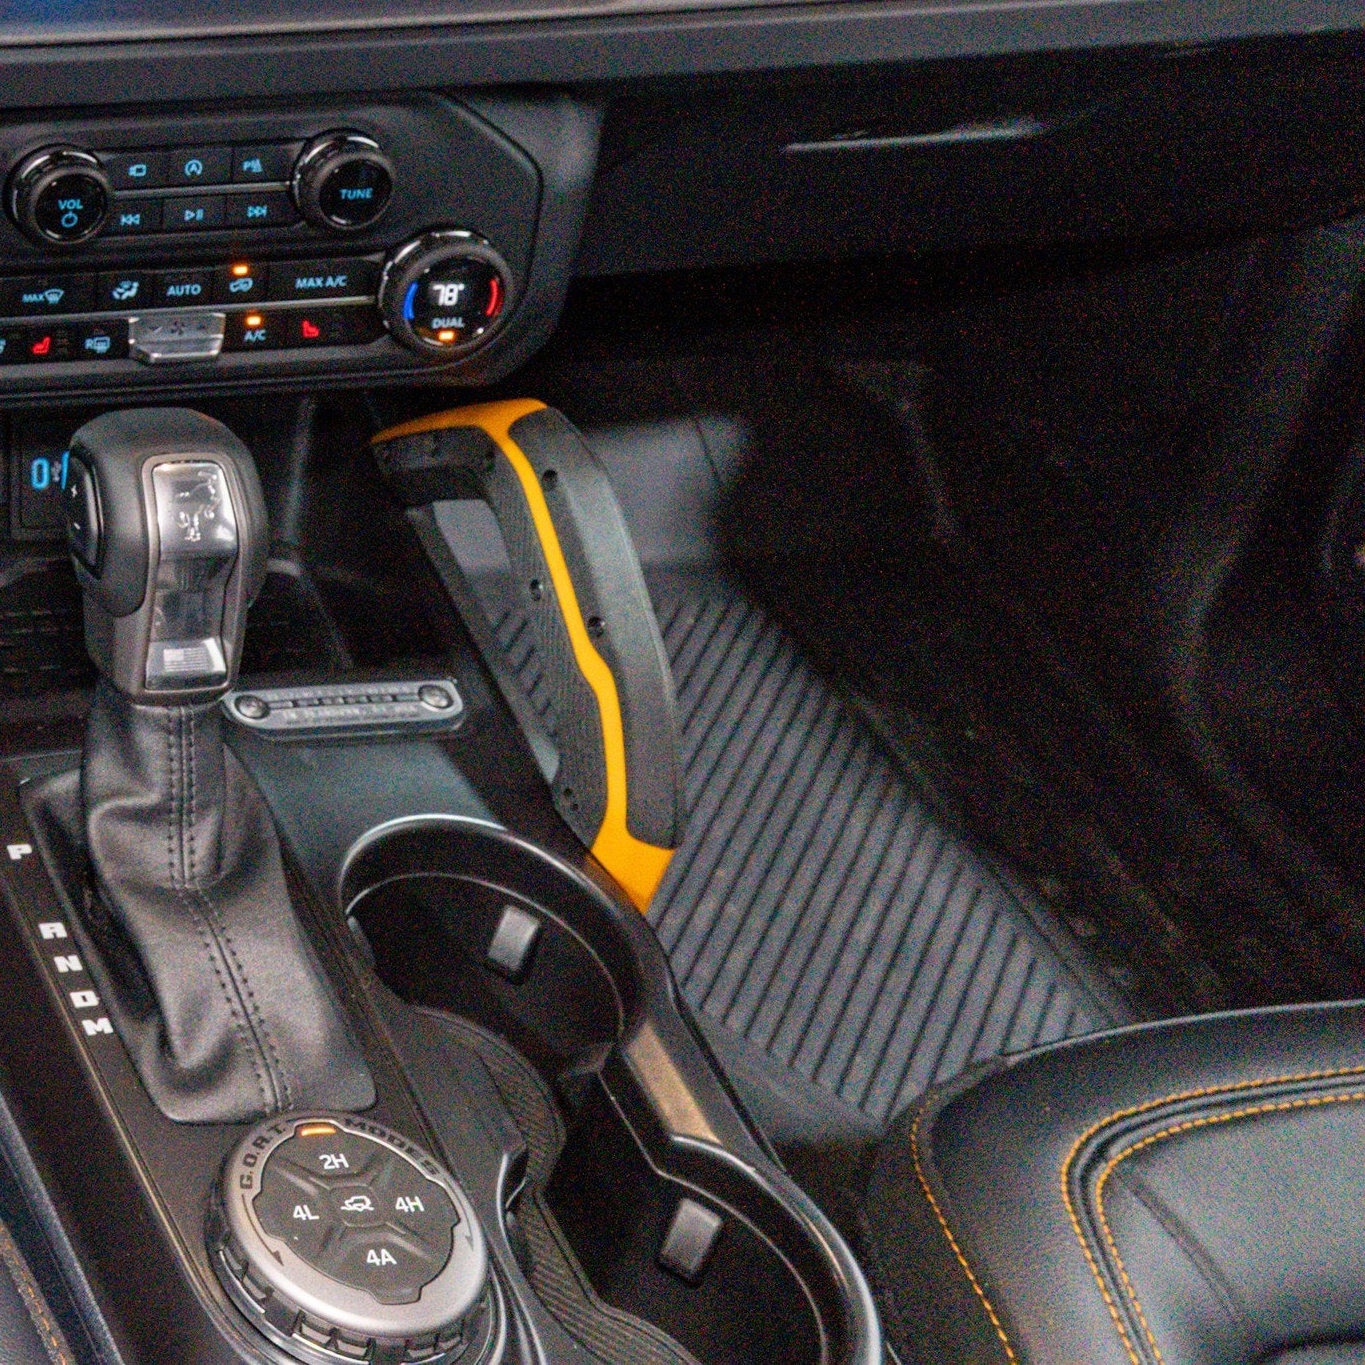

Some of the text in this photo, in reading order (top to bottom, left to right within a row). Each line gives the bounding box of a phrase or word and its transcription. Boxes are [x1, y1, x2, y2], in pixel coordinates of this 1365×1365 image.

[340, 188, 373, 200] TUNE
[57, 198, 83, 211] VOL
[166, 284, 202, 297] AUTO
[295, 275, 347, 290] MAX A/C
[22, 293, 44, 303] MAX
[432, 282, 465, 306] 78°
[431, 317, 465, 329] DUAL
[244, 329, 266, 342] A/C
[7, 843, 33, 860] P
[53, 955, 83, 973] N
[69, 990, 99, 1008] D
[81, 1017, 114, 1036] M
[344, 1117, 439, 1177] MODES
[319, 1153, 349, 1170] 2H
[292, 1196, 425, 1221] 4L 4H
[366, 1248, 398, 1266] 4A
